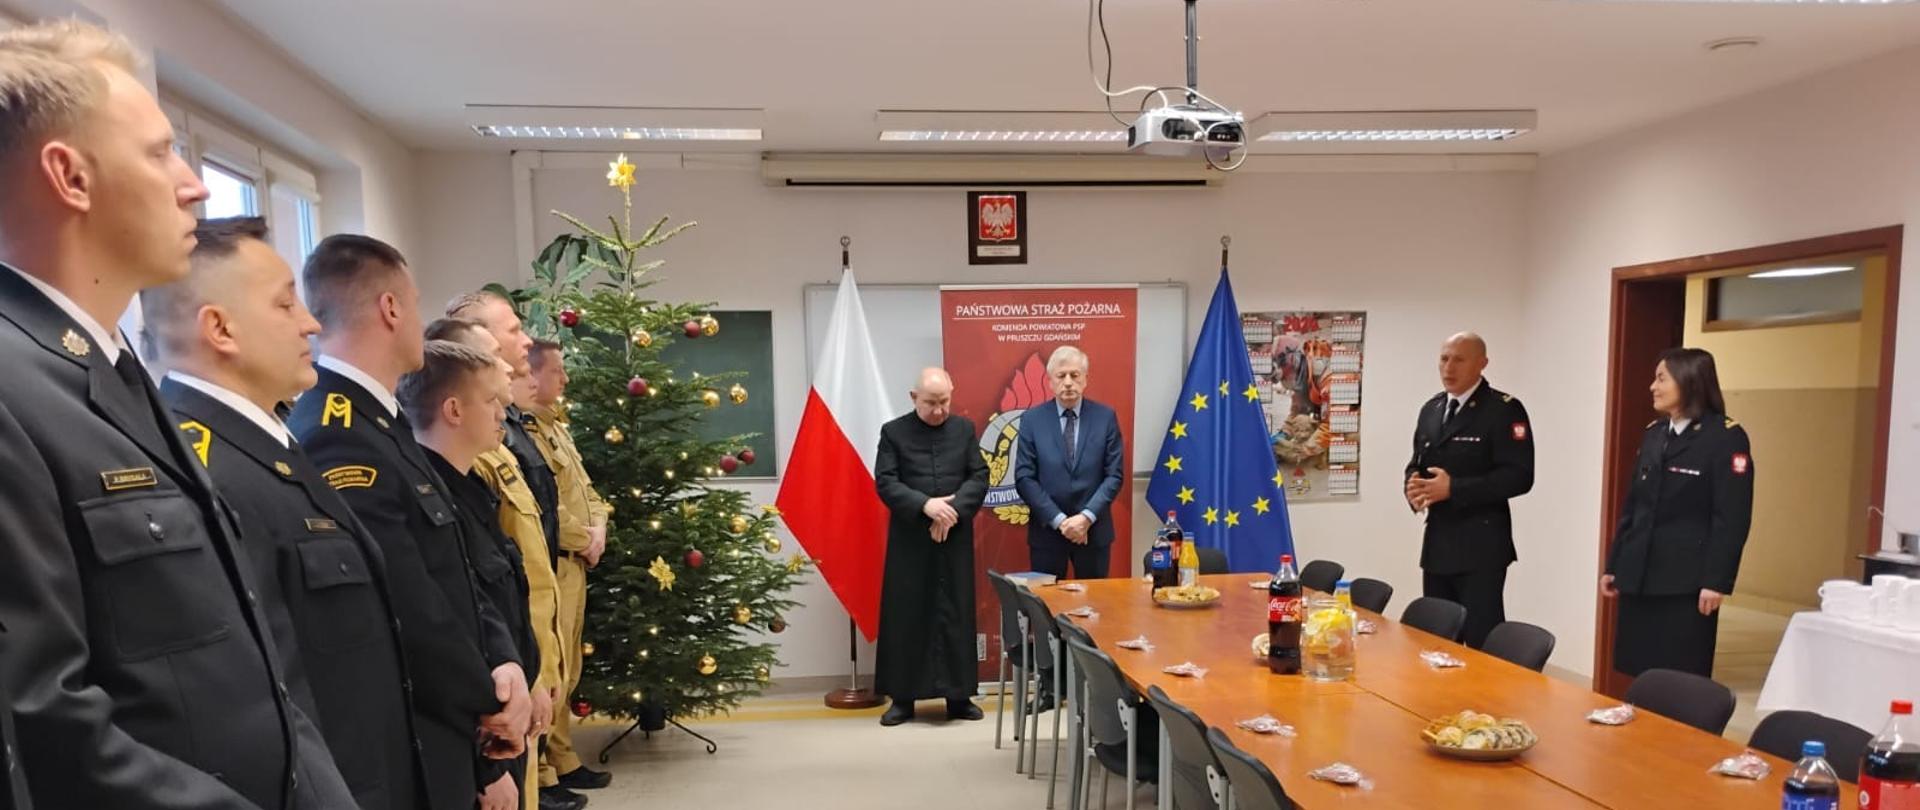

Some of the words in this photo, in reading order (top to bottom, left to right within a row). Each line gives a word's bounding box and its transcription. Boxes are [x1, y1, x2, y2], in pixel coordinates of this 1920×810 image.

[956, 302, 1028, 316] PAŃSTWOWA
[1031, 302, 1065, 315] STRAŻ
[1068, 302, 1121, 315] POŻARNA
[992, 324, 1028, 332] KOMENDA
[1029, 323, 1071, 331] POWIATOWA
